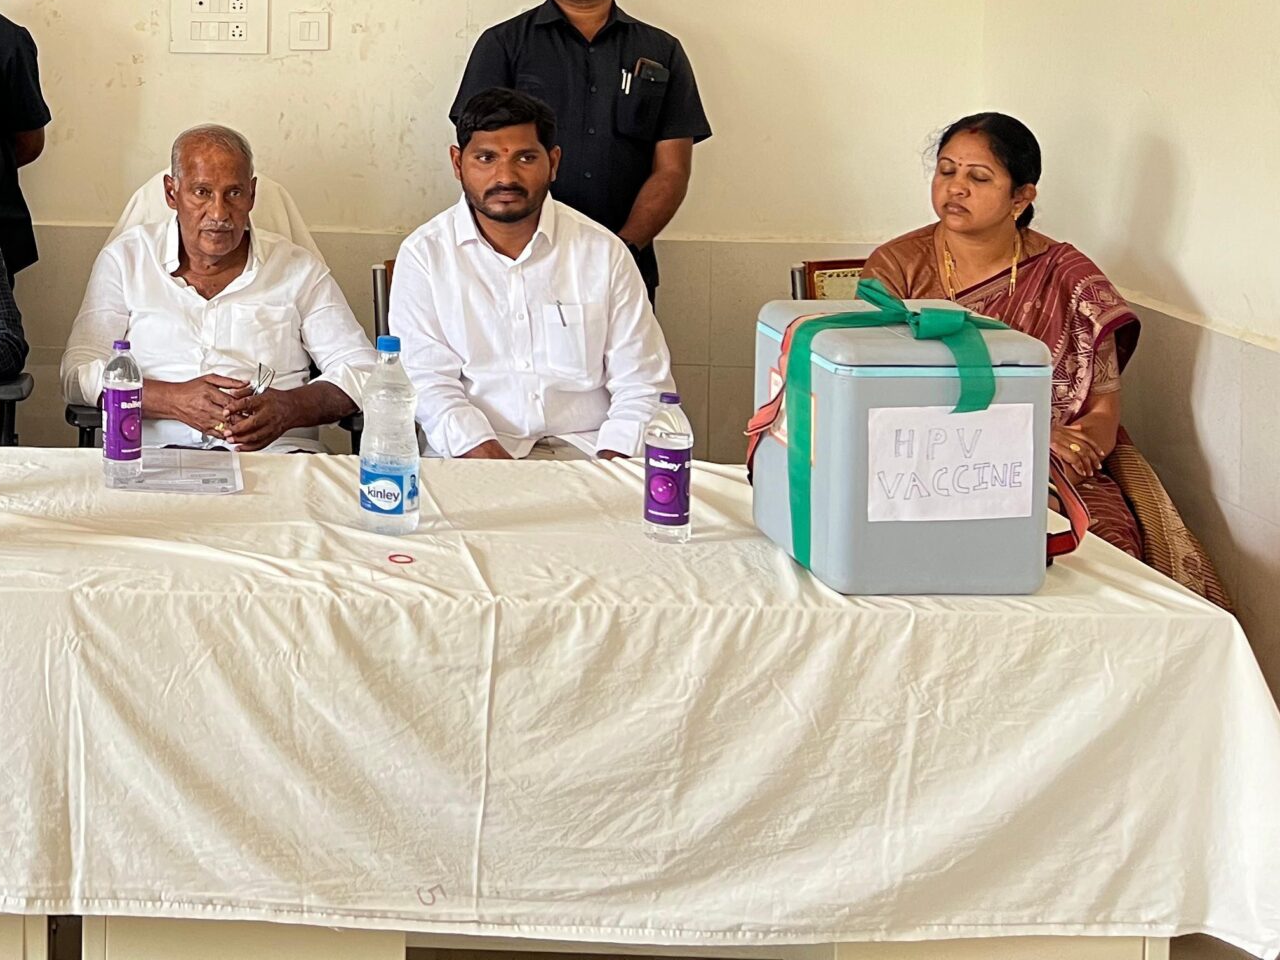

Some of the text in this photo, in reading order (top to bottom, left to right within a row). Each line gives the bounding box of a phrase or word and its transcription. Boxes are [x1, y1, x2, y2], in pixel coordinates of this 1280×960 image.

[894, 428, 982, 460] HPV
[367, 486, 400, 502] kinley
[876, 461, 1022, 500] VACCINE
